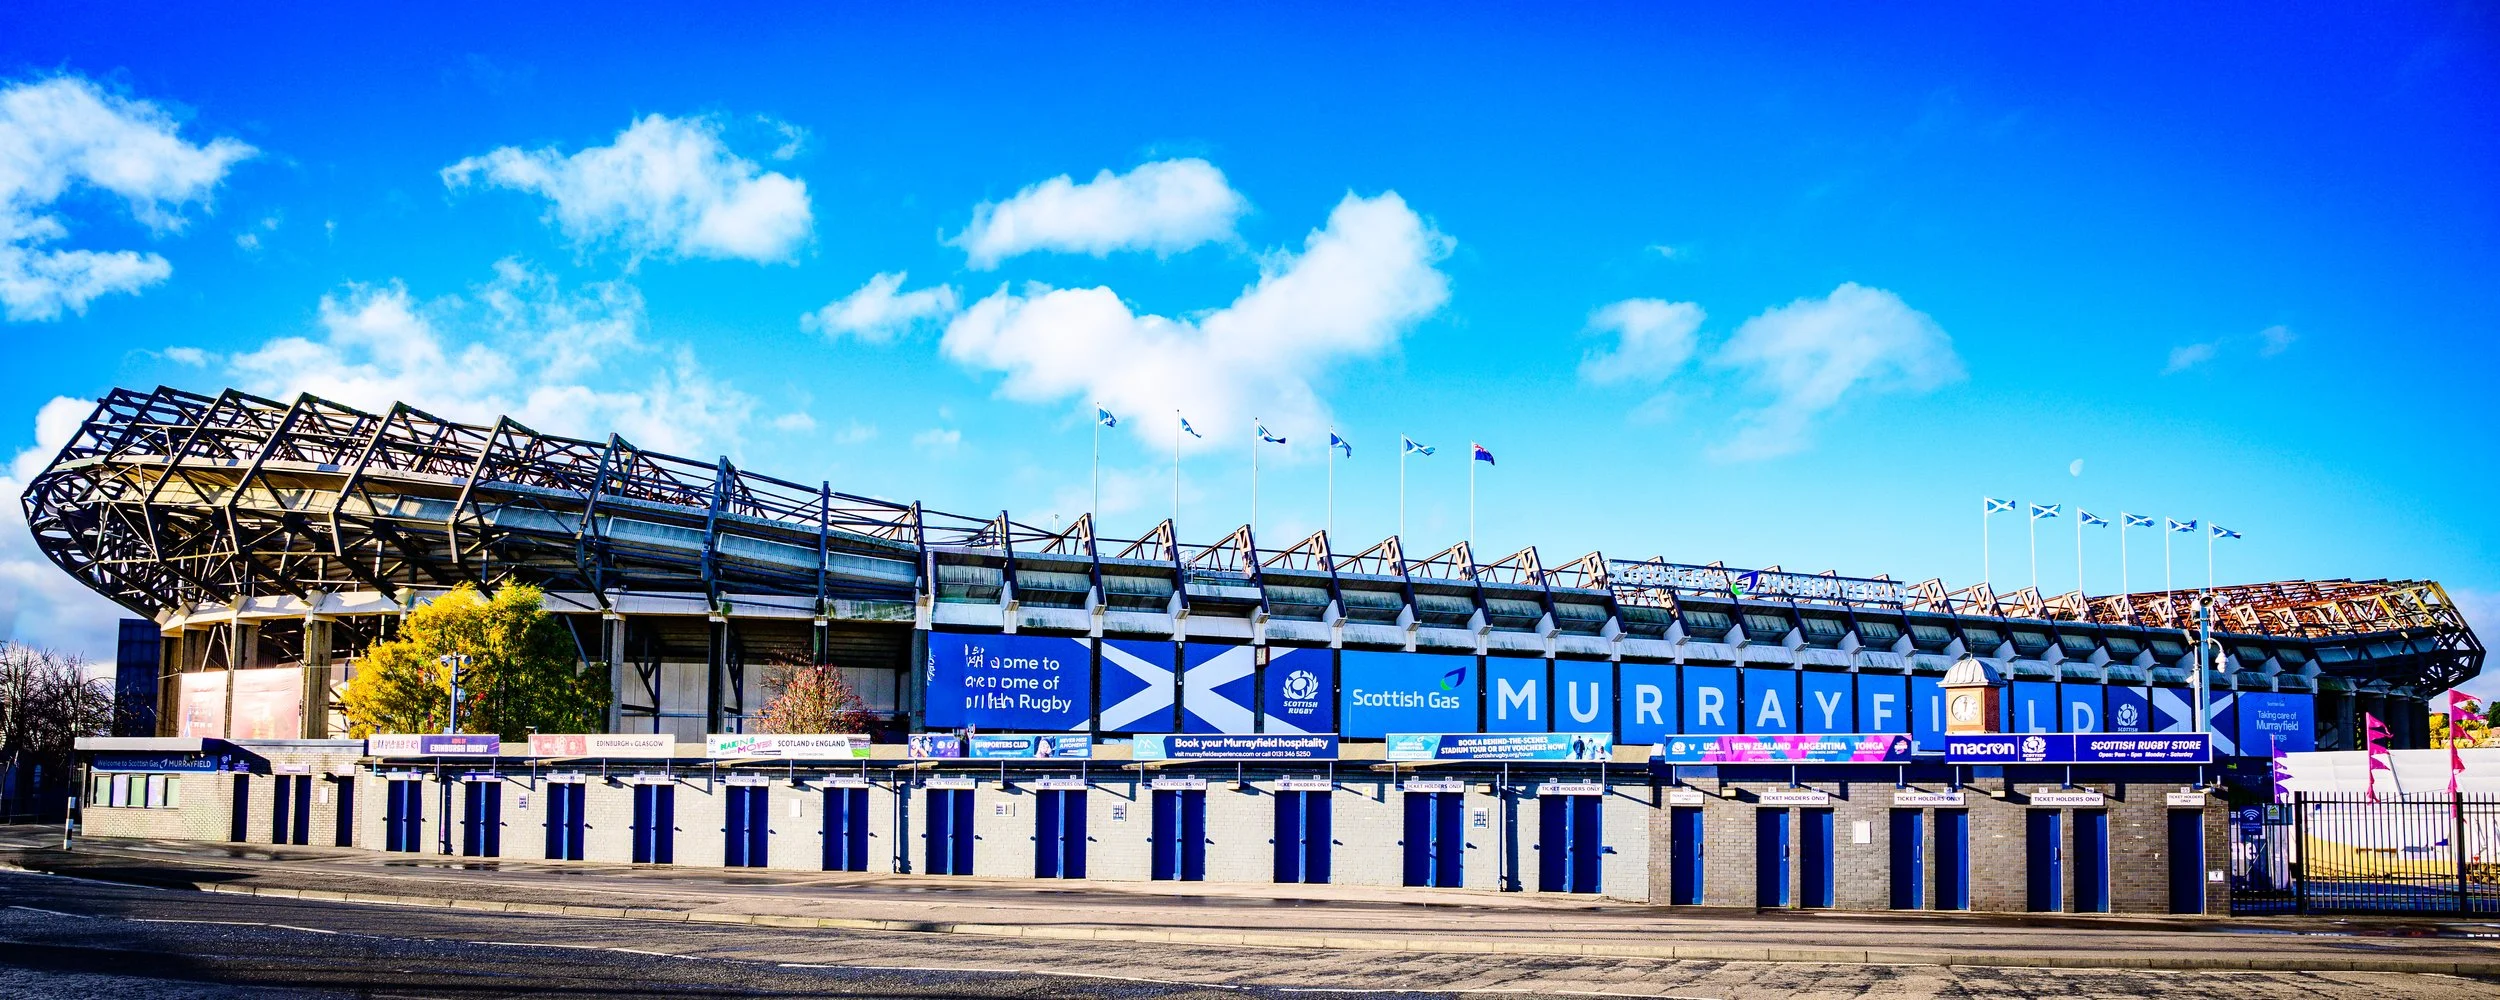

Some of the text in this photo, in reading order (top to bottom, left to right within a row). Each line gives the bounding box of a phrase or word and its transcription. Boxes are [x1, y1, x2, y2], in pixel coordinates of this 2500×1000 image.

[1043, 657, 1060, 670] to
[1043, 675, 1060, 690] of
[1019, 694, 1072, 713] Rugby
[1352, 689, 1460, 709] Scottish Gas
[1283, 700, 1318, 708] SCOTTISH
[1497, 678, 2095, 733] MURRAYFILD
[1288, 707, 1314, 715] RUGBY
[2257, 710, 2297, 720] Taking care of
[2256, 720, 2299, 732] Murrayfield
[1012, 741, 1029, 749] CLUB
[1174, 738, 1329, 751] Book your Murrayfield hospitality
[1482, 737, 1548, 745] BEHIND-THE-SCENES
[2091, 740, 2201, 750] SCOTTISH RUGBY STORE
[1512, 744, 1547, 752] VOUCHERS
[1547, 743, 1566, 751] NOW!
[1703, 742, 1720, 751] USA
[1732, 742, 1791, 751] NEW ZEALAND
[1798, 742, 1847, 751] ARGENTINA
[1854, 742, 1884, 751] TONGA
[1950, 742, 2015, 755] macron
[97, 759, 120, 767] Welcome
[128, 759, 149, 767] Scottish
[149, 760, 159, 768] Gas
[168, 760, 211, 768] MURRAYFIELD
